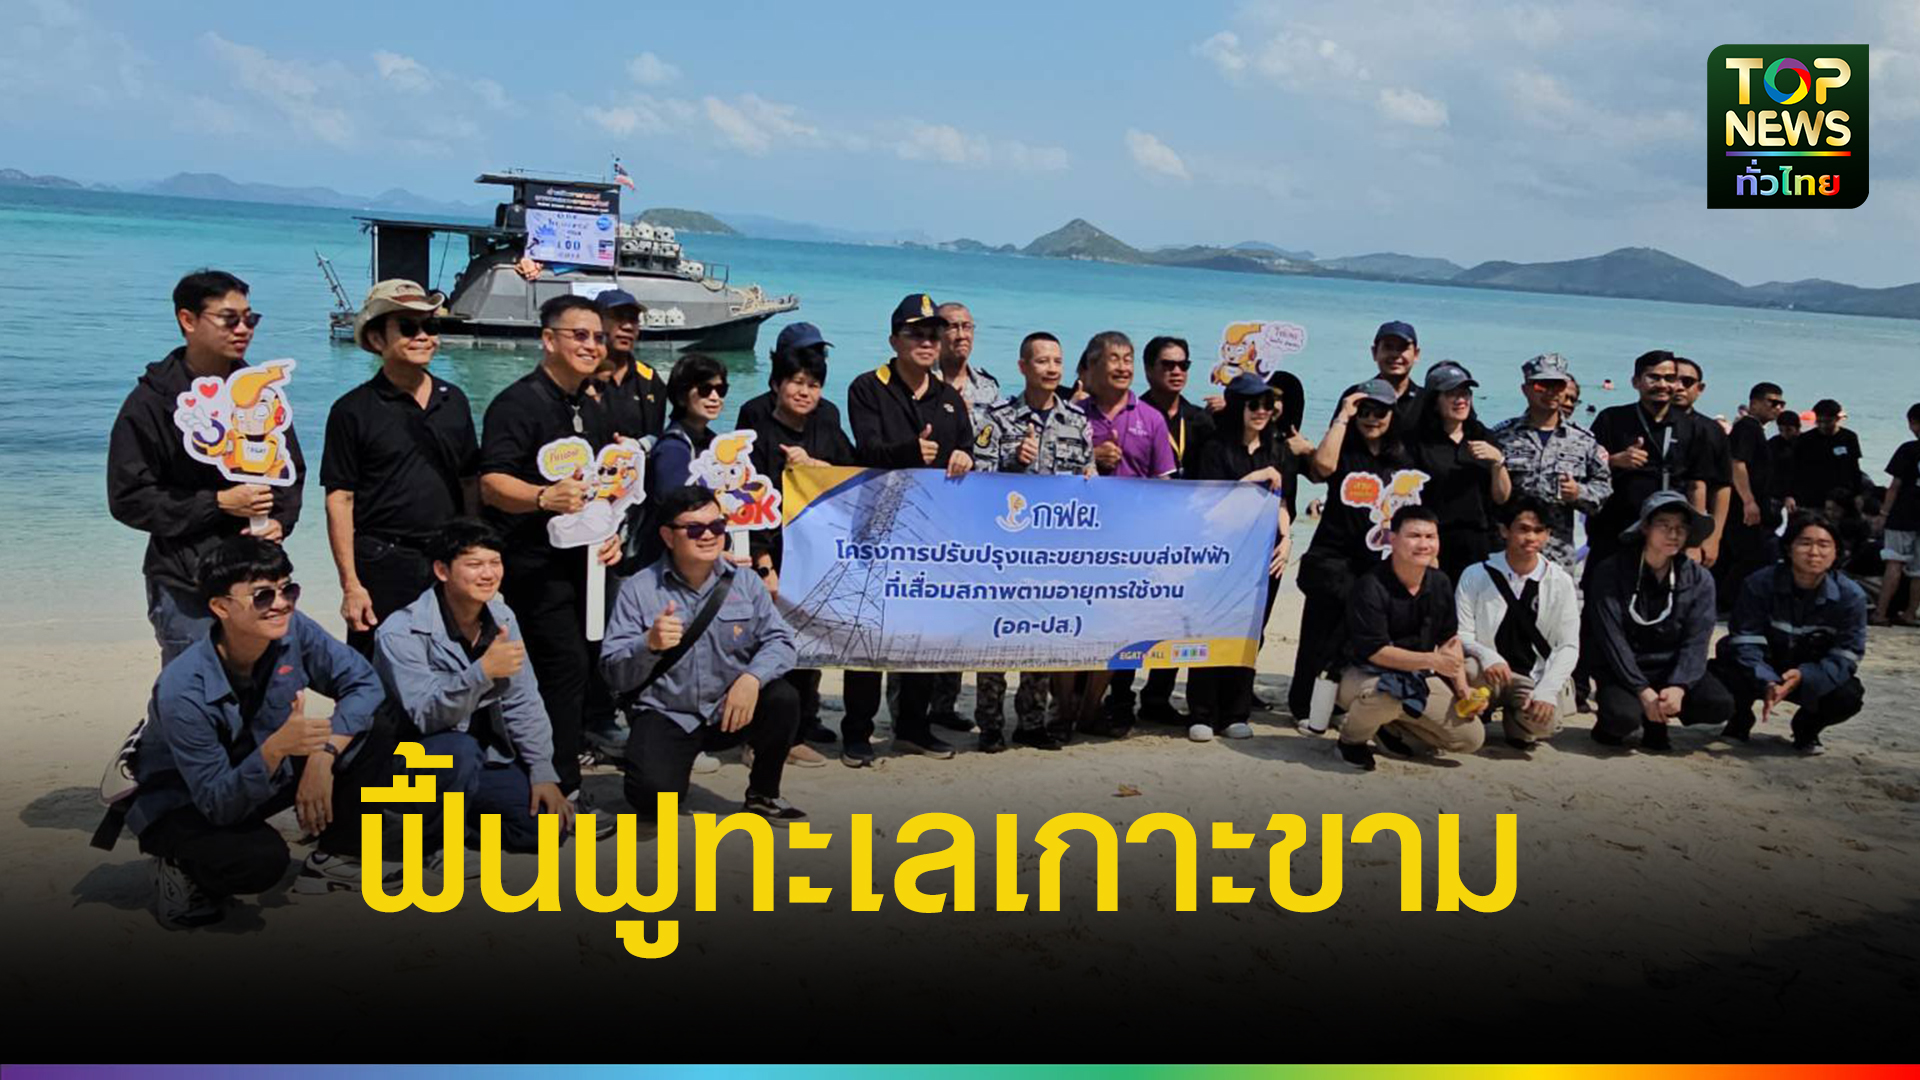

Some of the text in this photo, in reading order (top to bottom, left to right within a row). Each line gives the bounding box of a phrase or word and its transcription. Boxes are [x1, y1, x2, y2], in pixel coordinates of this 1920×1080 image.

[1032, 500, 1100, 528] กฟผ.
[835, 539, 1231, 571] โครงการปรับปรุงและขยายระบบส่งไฟฟ้า
[885, 570, 1185, 606] ที่เสื่อมสภาพตามอายุการใช้งาน
[993, 616, 1083, 638] (อค-ปส.)
